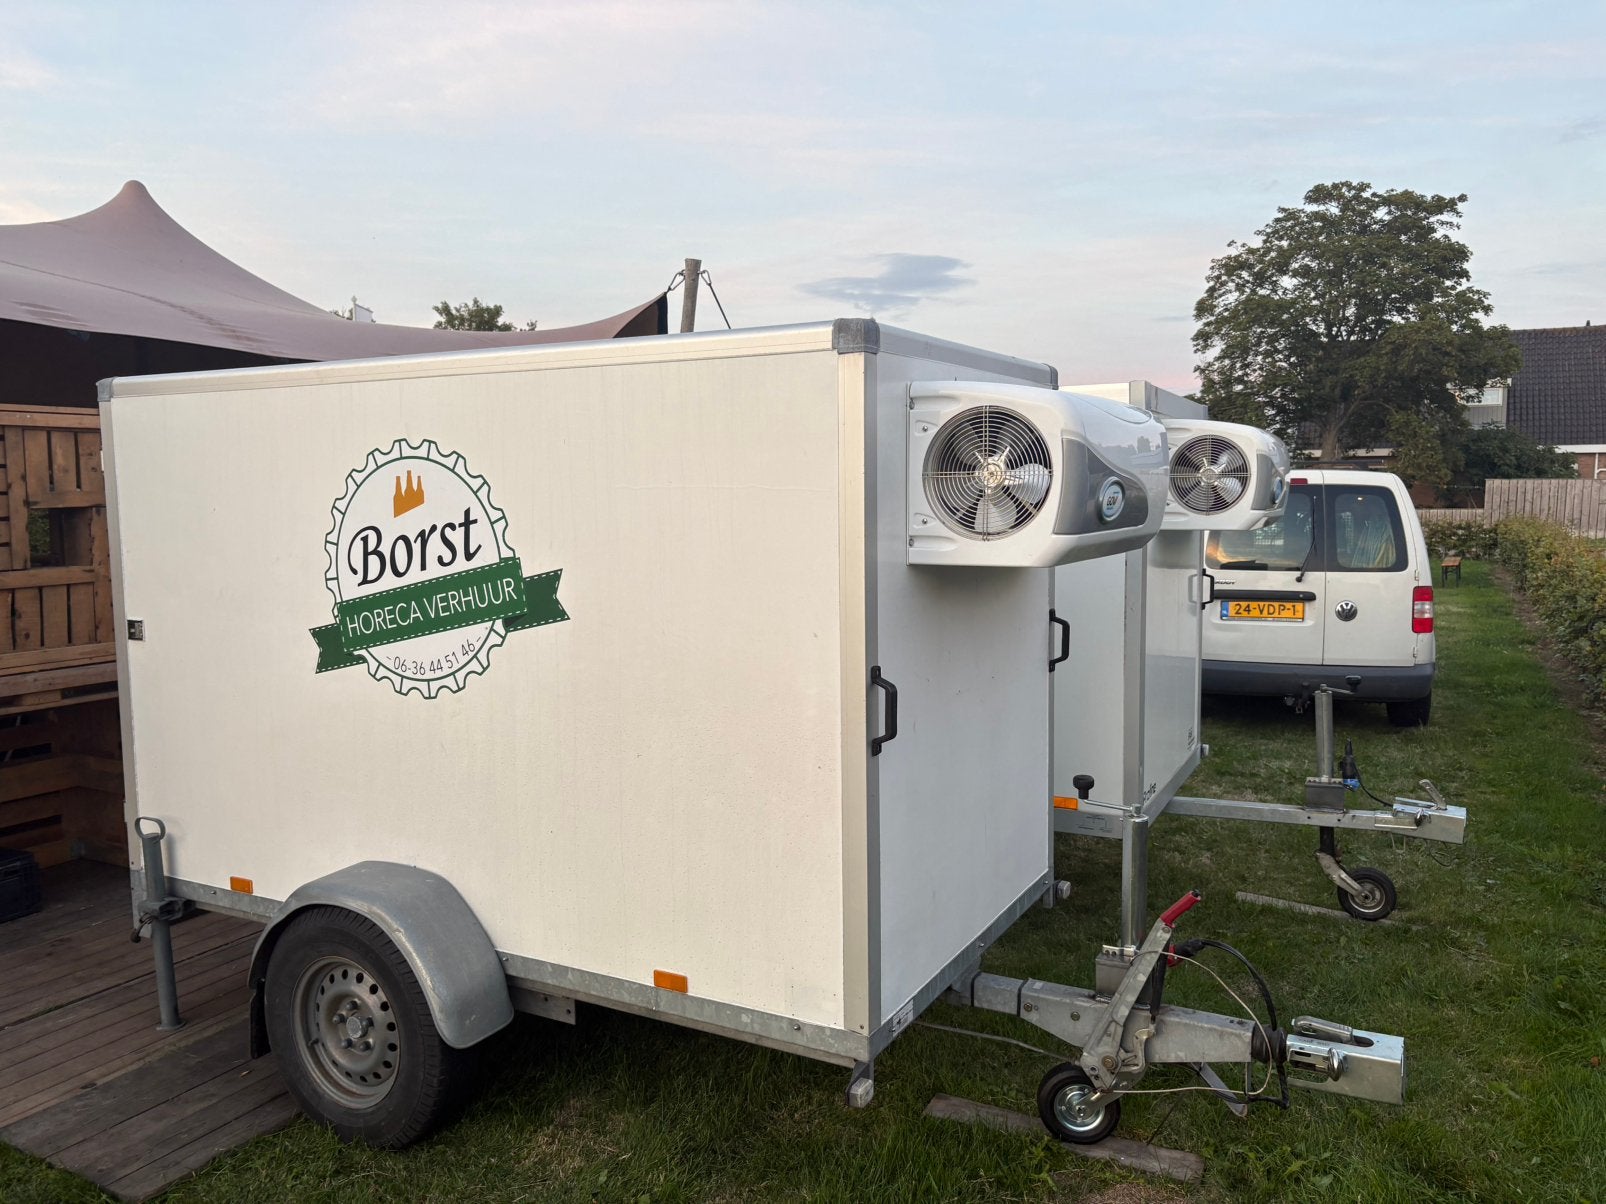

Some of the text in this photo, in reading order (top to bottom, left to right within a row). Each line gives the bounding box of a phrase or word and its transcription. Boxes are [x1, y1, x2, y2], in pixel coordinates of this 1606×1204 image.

[348, 506, 482, 587] Borst
[346, 577, 517, 638] HORECA VERHUUR
[1234, 603, 1297, 616] 24-VDP-1
[393, 639, 476, 676] 06-36 44 51 46
